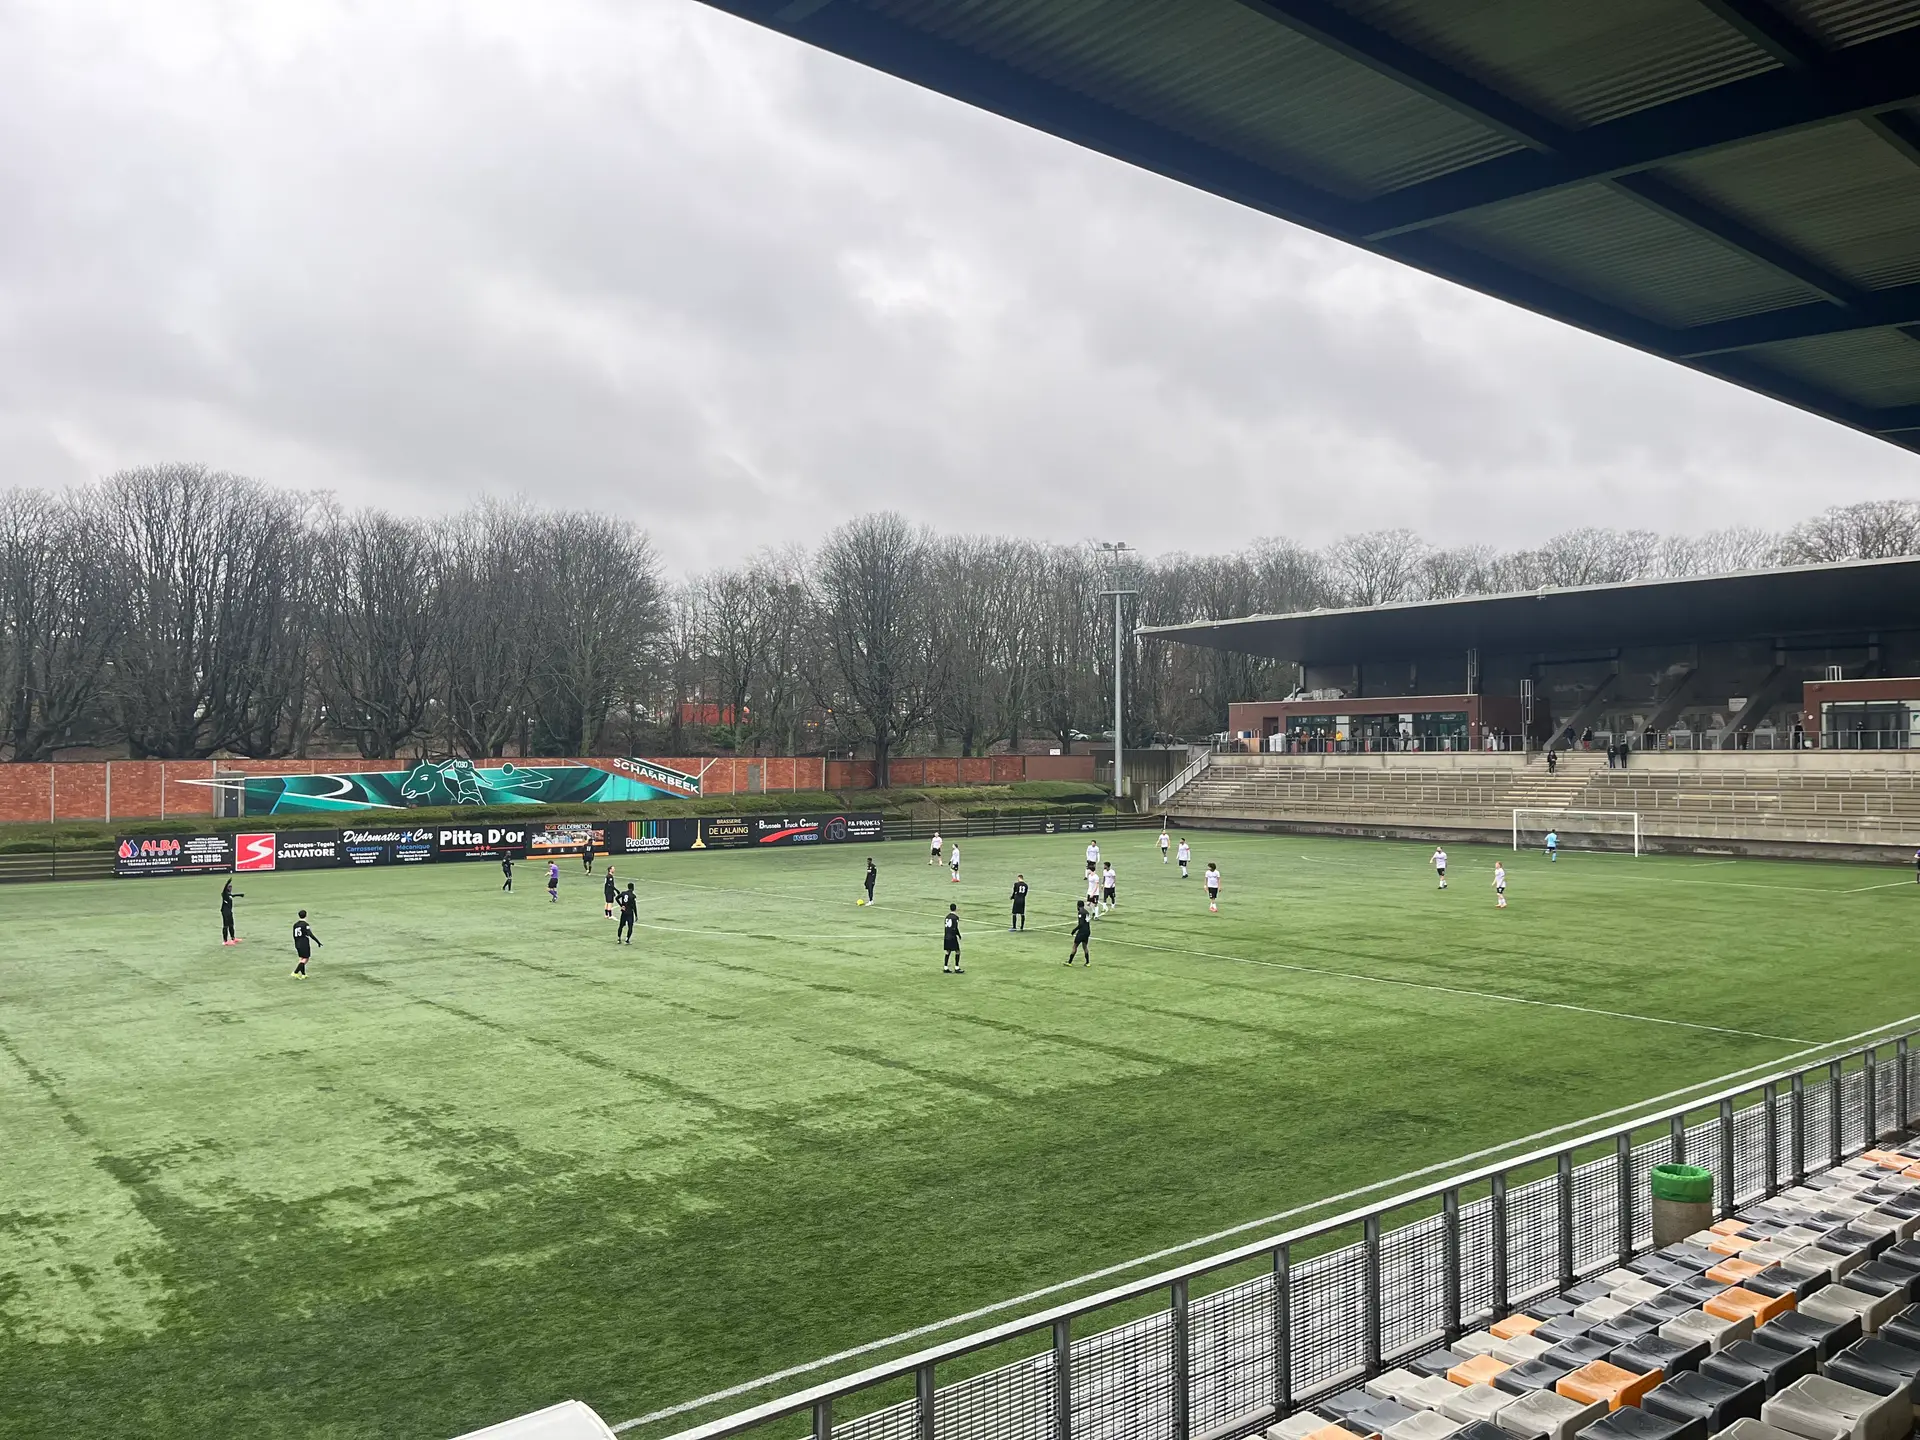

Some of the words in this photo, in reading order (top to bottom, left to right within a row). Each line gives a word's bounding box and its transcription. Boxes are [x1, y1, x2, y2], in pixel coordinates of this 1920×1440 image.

[759, 820, 781, 829] Brussels
[784, 819, 798, 827] Truck
[800, 818, 818, 827] Center
[343, 830, 400, 845] Diplomatic
[413, 828, 433, 842] Car
[440, 830, 483, 845] Pitta
[488, 829, 525, 844] D'or
[626, 837, 669, 847] Produstore
[141, 839, 181, 852] ALBA
[278, 848, 335, 858] SALVATORE
